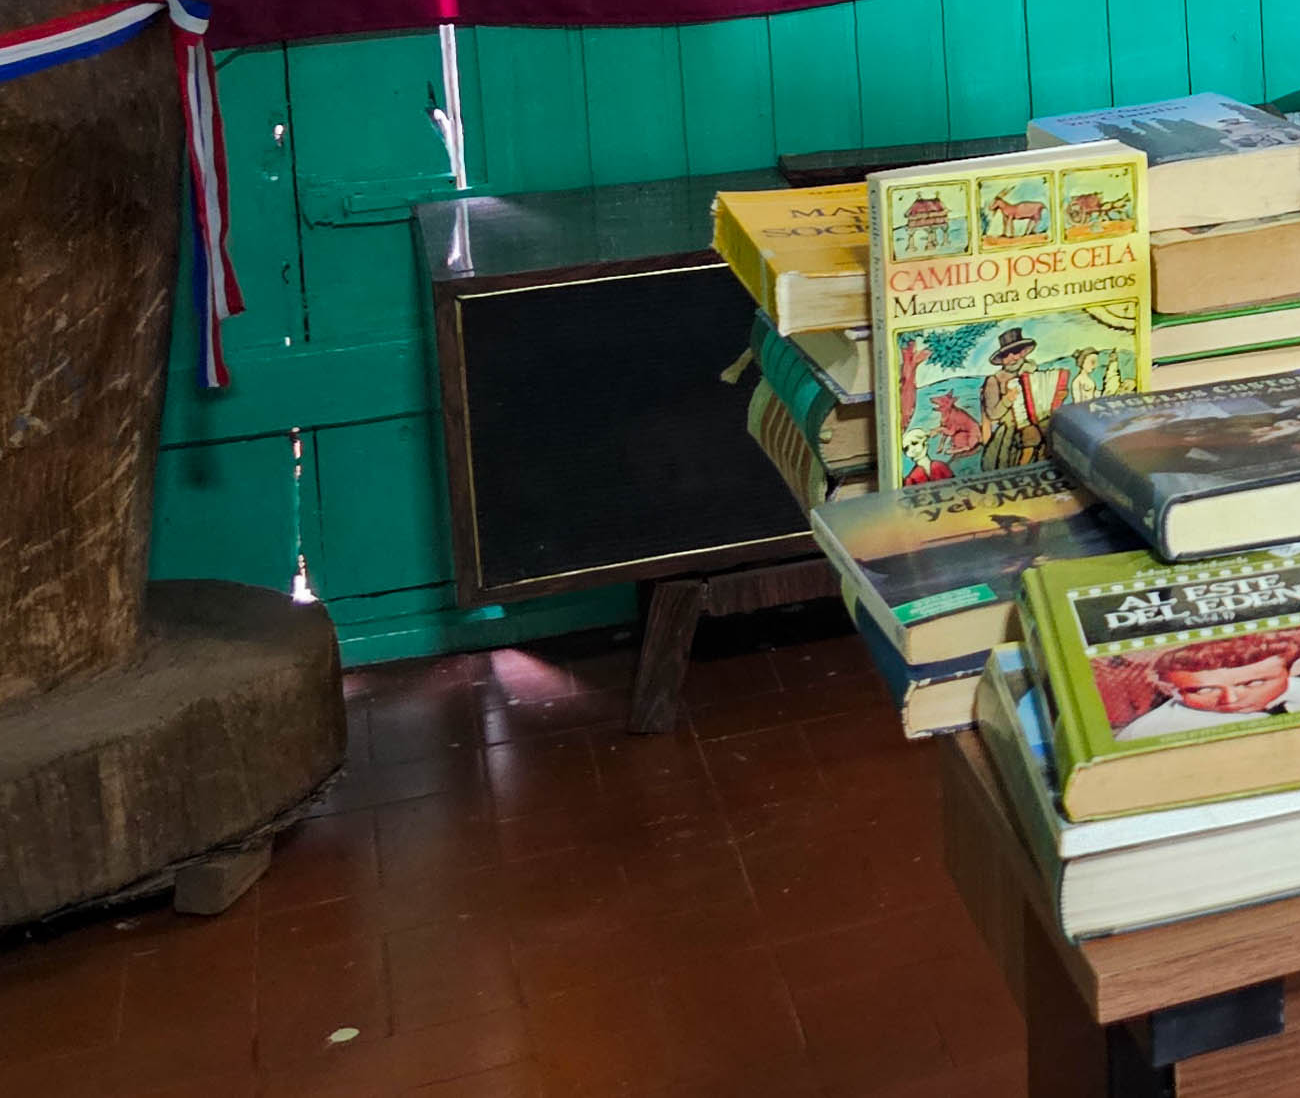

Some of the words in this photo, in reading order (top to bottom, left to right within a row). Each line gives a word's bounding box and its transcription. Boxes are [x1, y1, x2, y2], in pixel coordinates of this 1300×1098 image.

[890, 259, 1000, 293] CAMILO
[1005, 249, 1067, 286] JOSÉ
[1071, 245, 1137, 268] CELA
[893, 293, 976, 319] Mazurca
[983, 290, 1020, 315] para
[1026, 278, 1060, 300] dos
[1063, 273, 1136, 296] muertos
[947, 497, 976, 514] el
[1117, 591, 1178, 612] AL
[1182, 573, 1286, 602] ESTE
[1104, 604, 1192, 630] DEL
